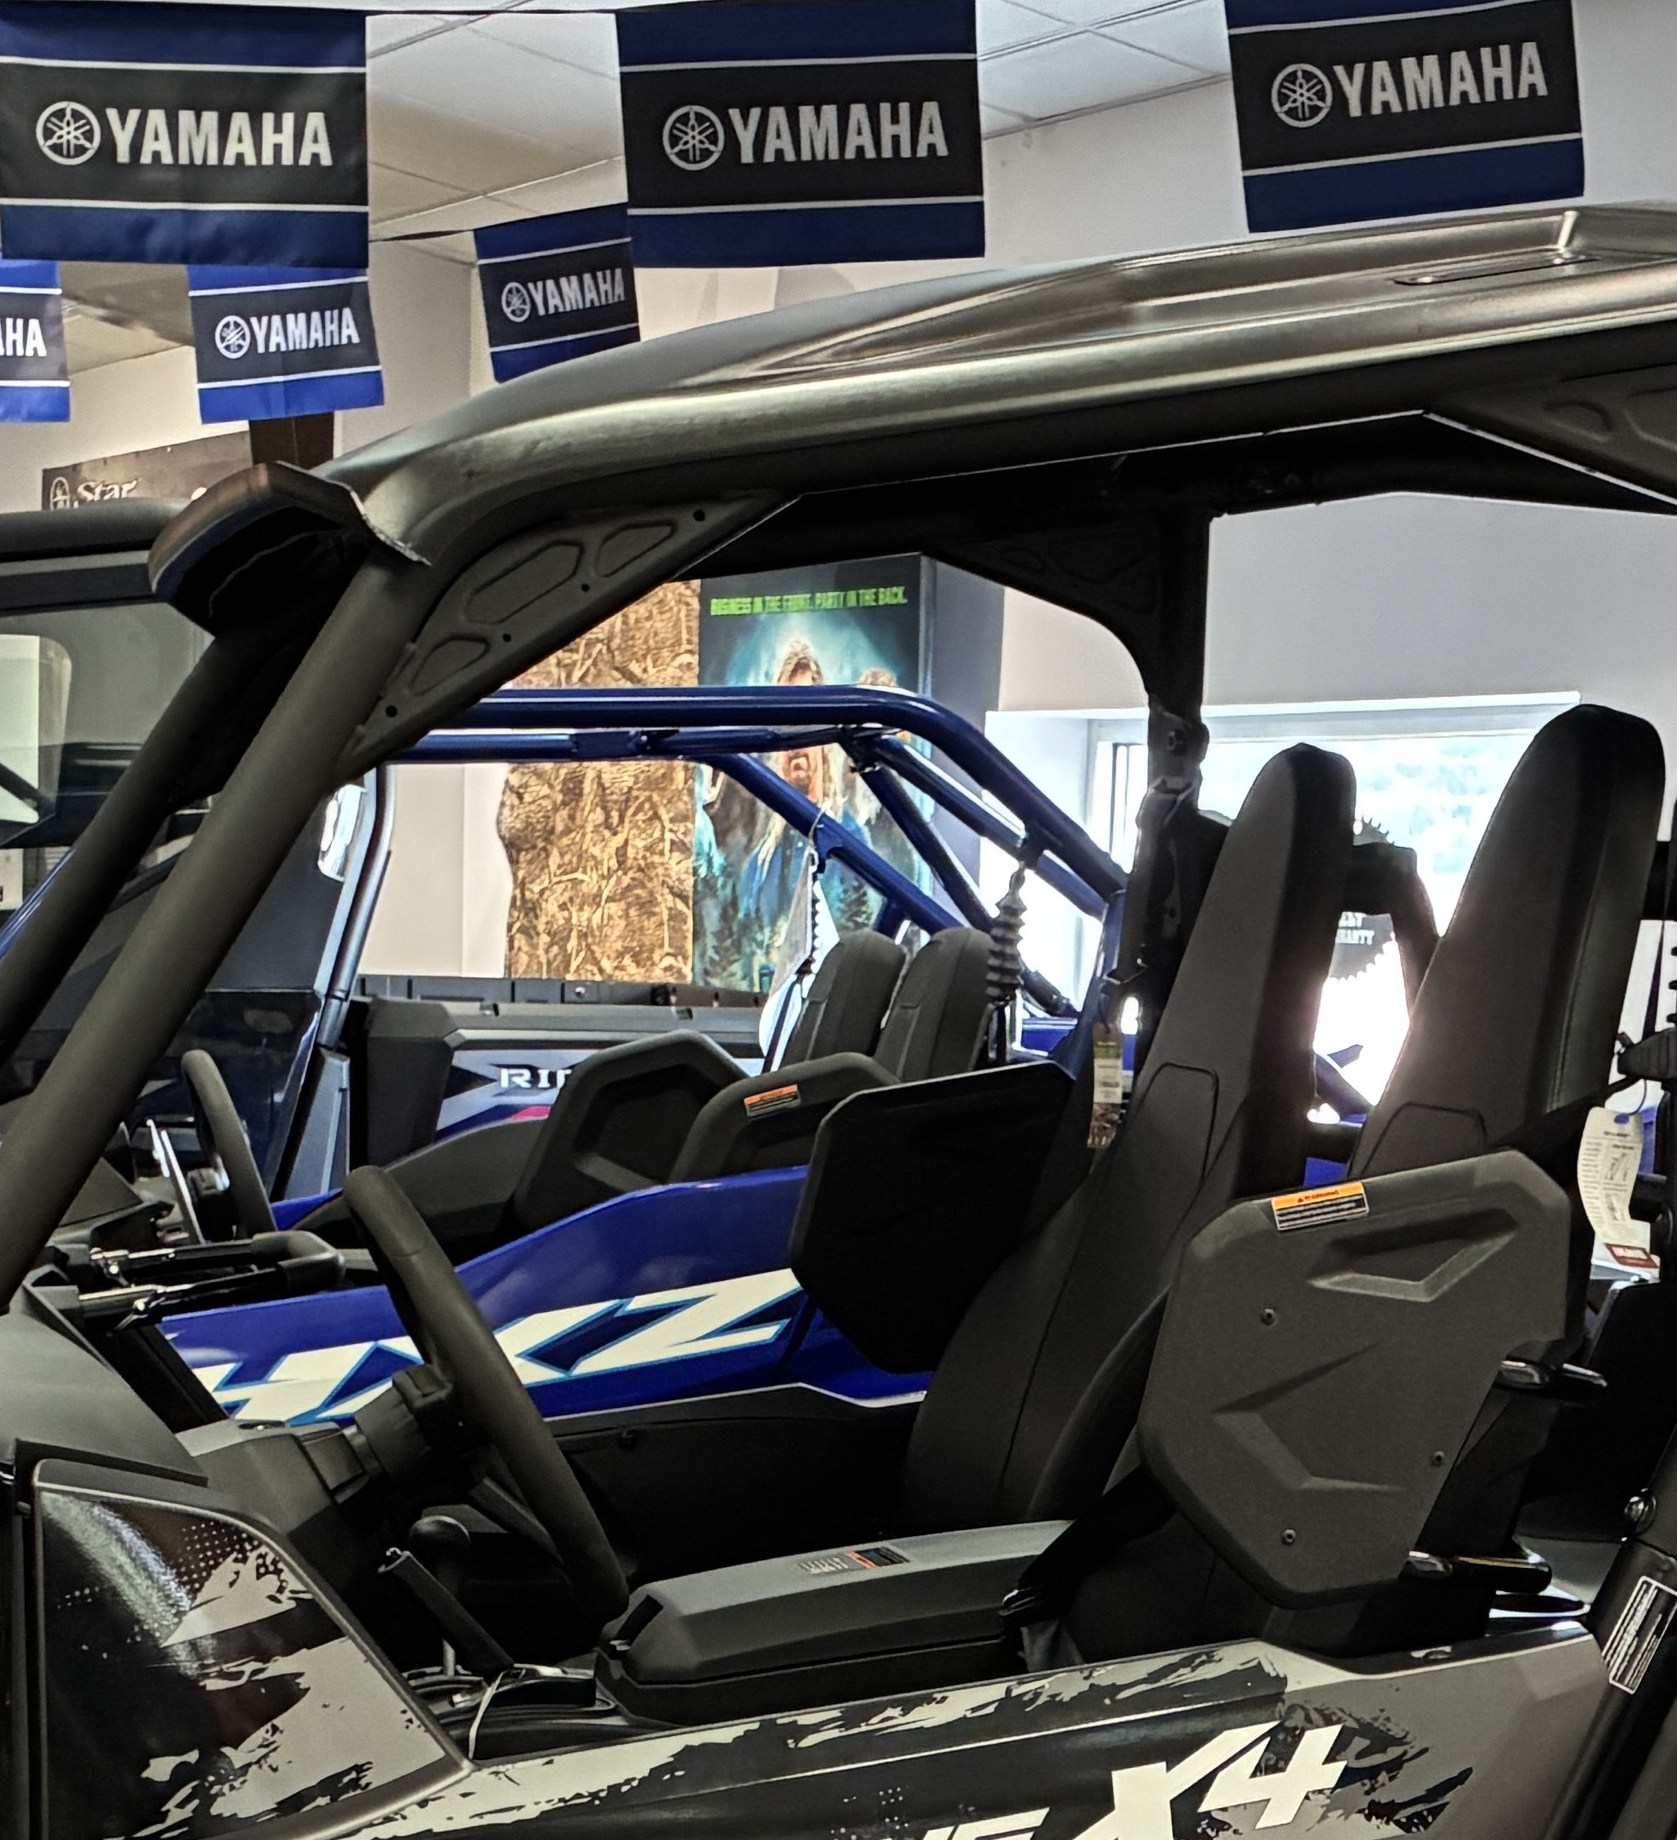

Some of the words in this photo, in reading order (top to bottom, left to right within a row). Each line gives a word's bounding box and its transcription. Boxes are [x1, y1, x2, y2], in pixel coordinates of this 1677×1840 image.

[1332, 41, 1548, 119] YAMAHA
[106, 107, 332, 168] YAMAHA
[727, 101, 948, 164] YAMAHA
[530, 268, 625, 314] YAMAHA
[250, 307, 360, 354] YAMAHA
